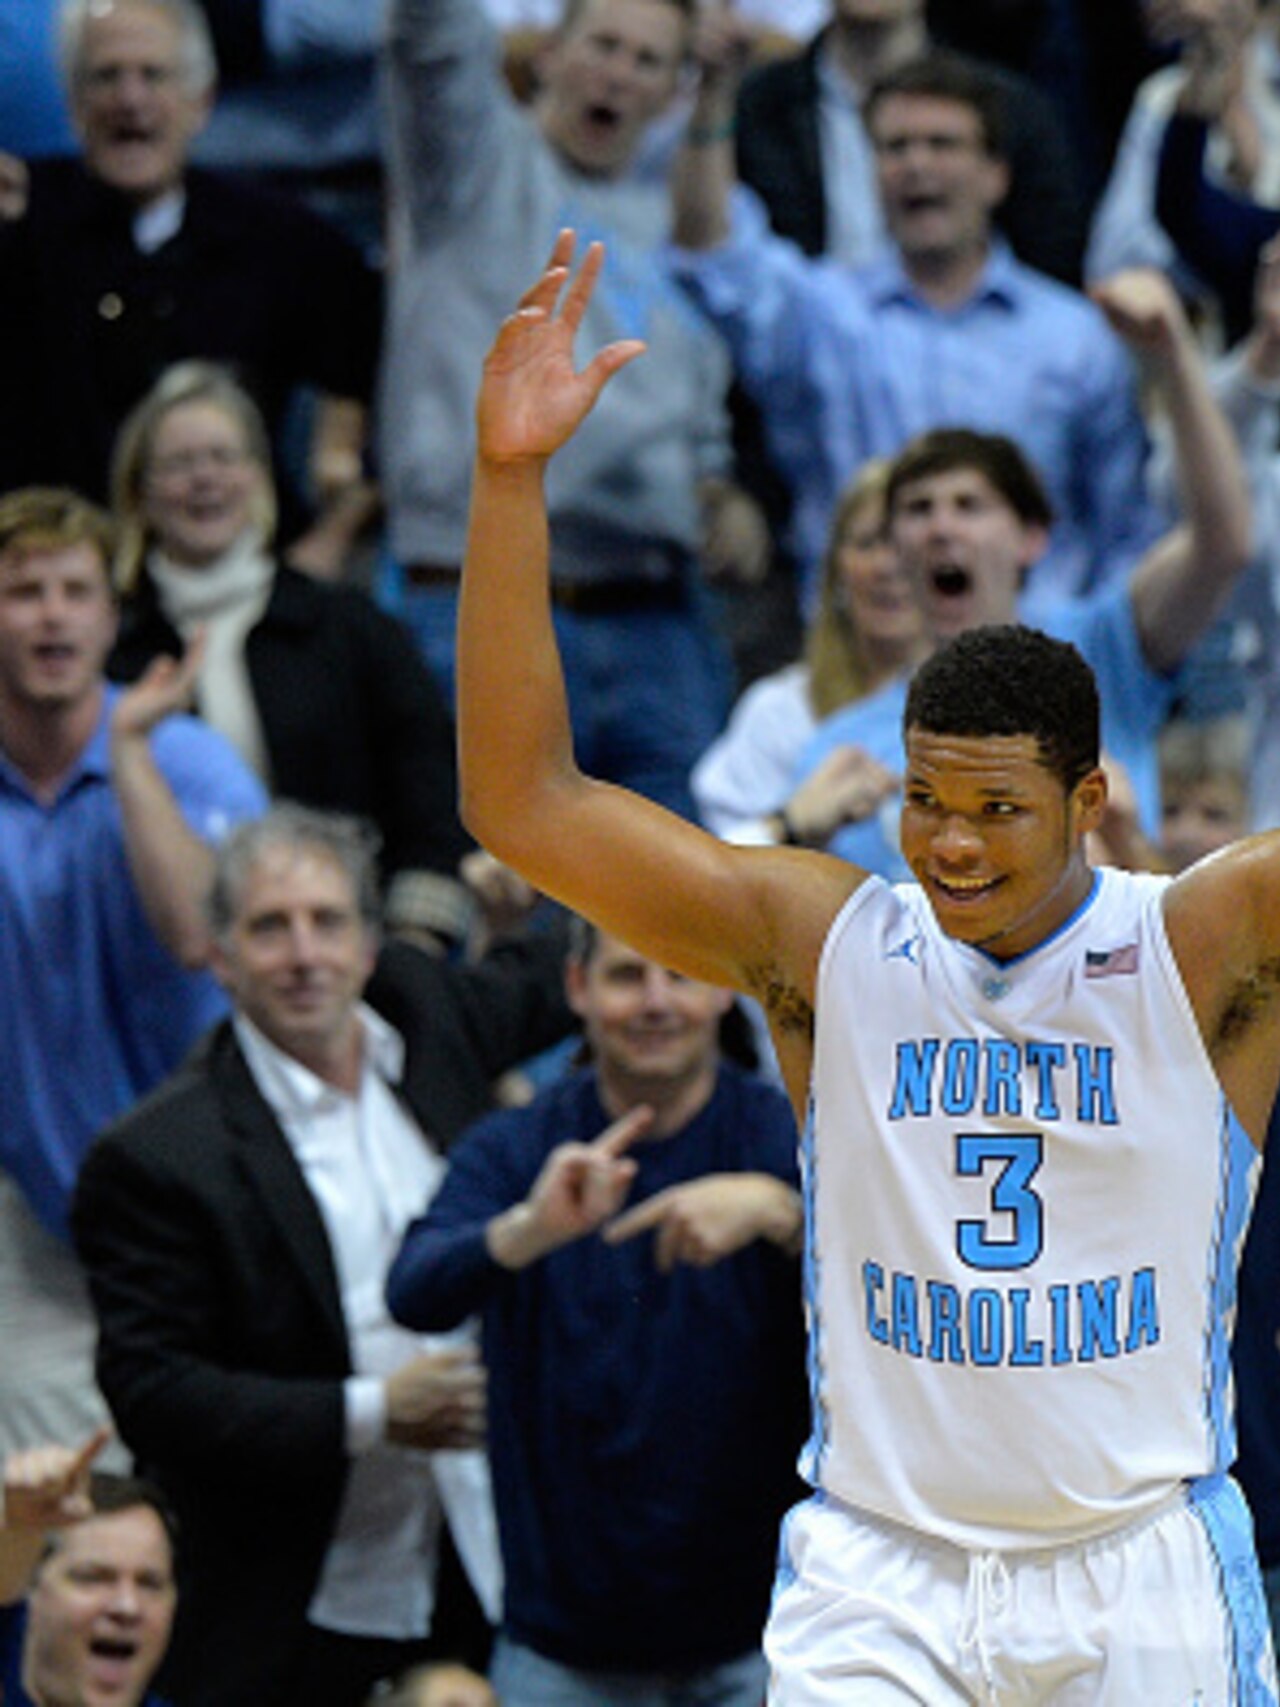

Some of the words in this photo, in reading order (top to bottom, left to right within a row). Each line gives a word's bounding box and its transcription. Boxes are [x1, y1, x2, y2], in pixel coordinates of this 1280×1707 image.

[887, 1038, 1120, 1125] NORTH
[955, 1133, 1044, 1271] 3
[861, 1258, 1161, 1367] CAROLINA
